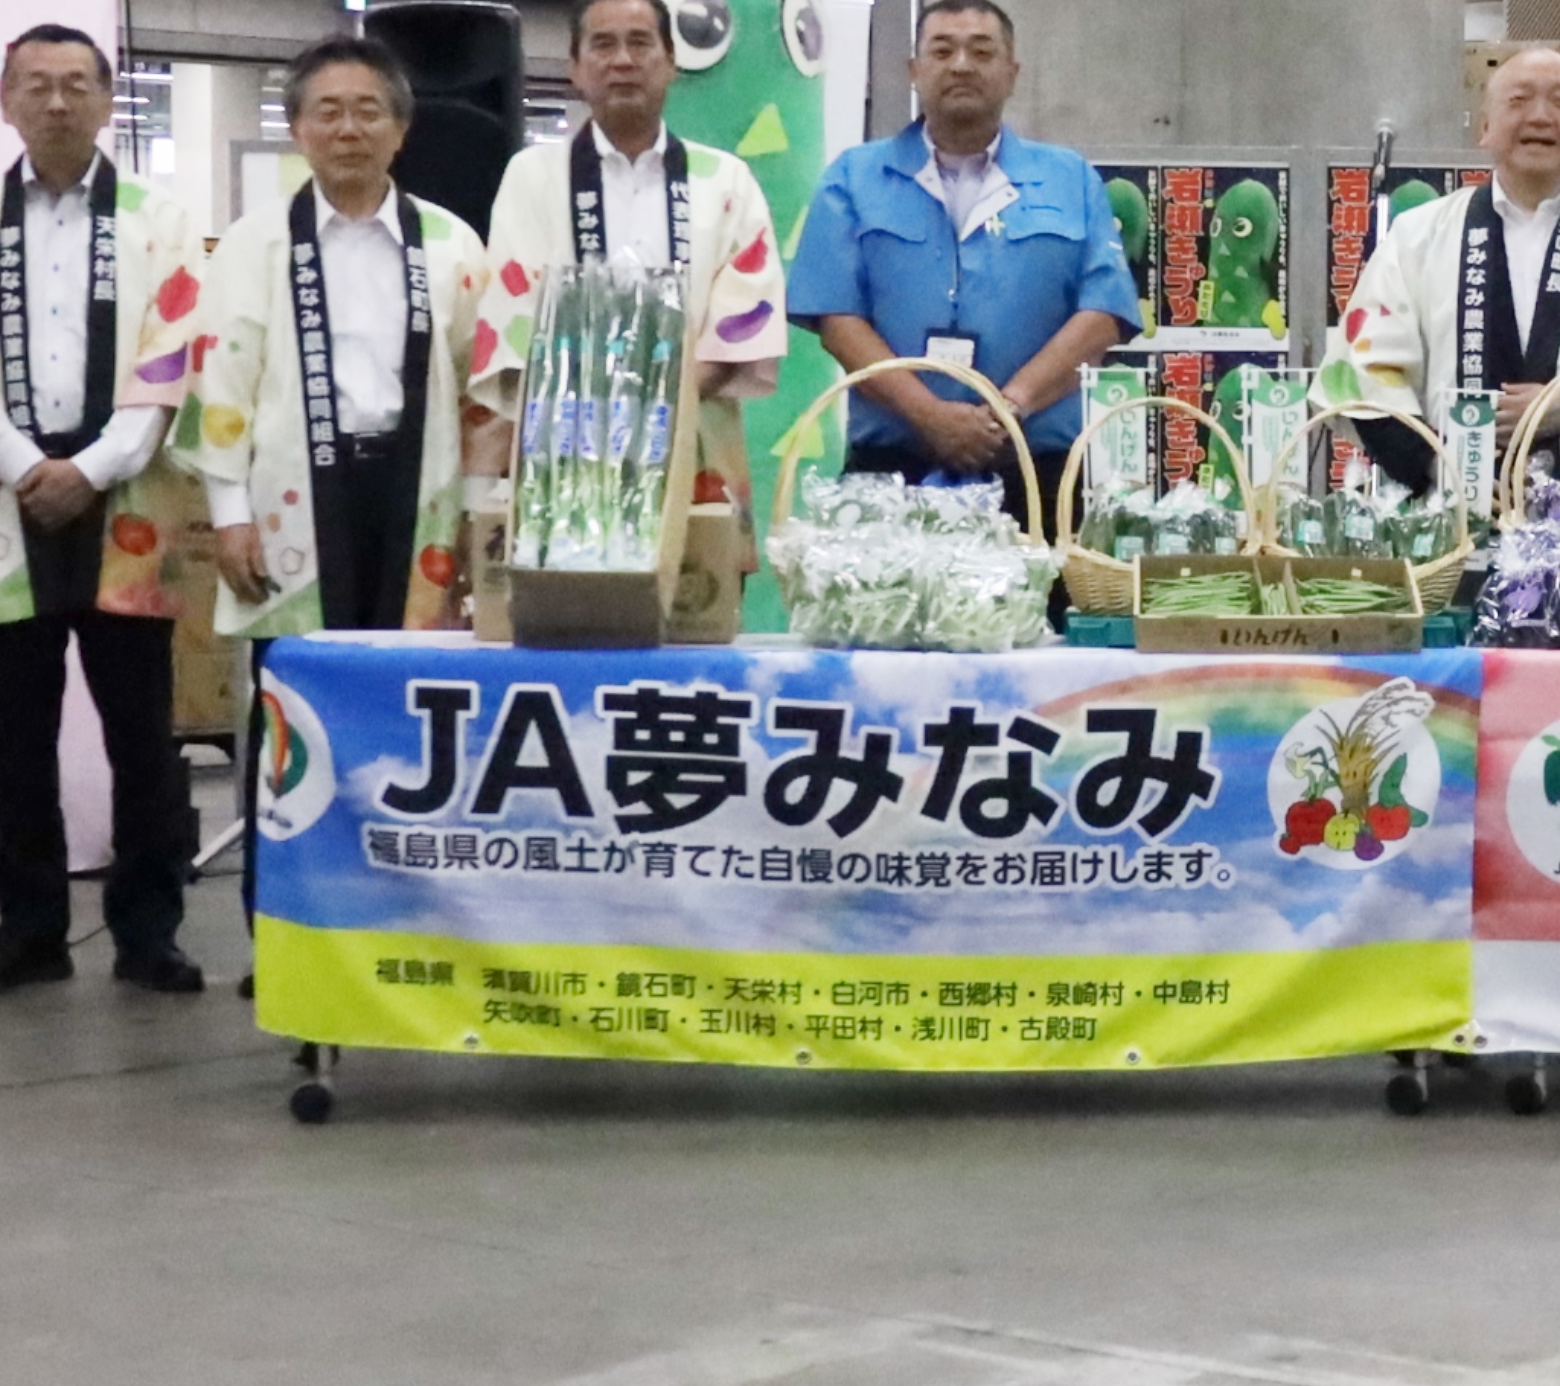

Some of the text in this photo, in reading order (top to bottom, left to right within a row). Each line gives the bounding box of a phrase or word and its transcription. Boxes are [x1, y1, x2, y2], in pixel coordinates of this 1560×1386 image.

[1466, 431, 1482, 502] きゅうり
[381, 686, 1219, 838] JA夢みなみ
[368, 828, 1232, 886] 福島県の風土が育てた自慢の味覚をお届けします。
[376, 958, 455, 987] 福島県
